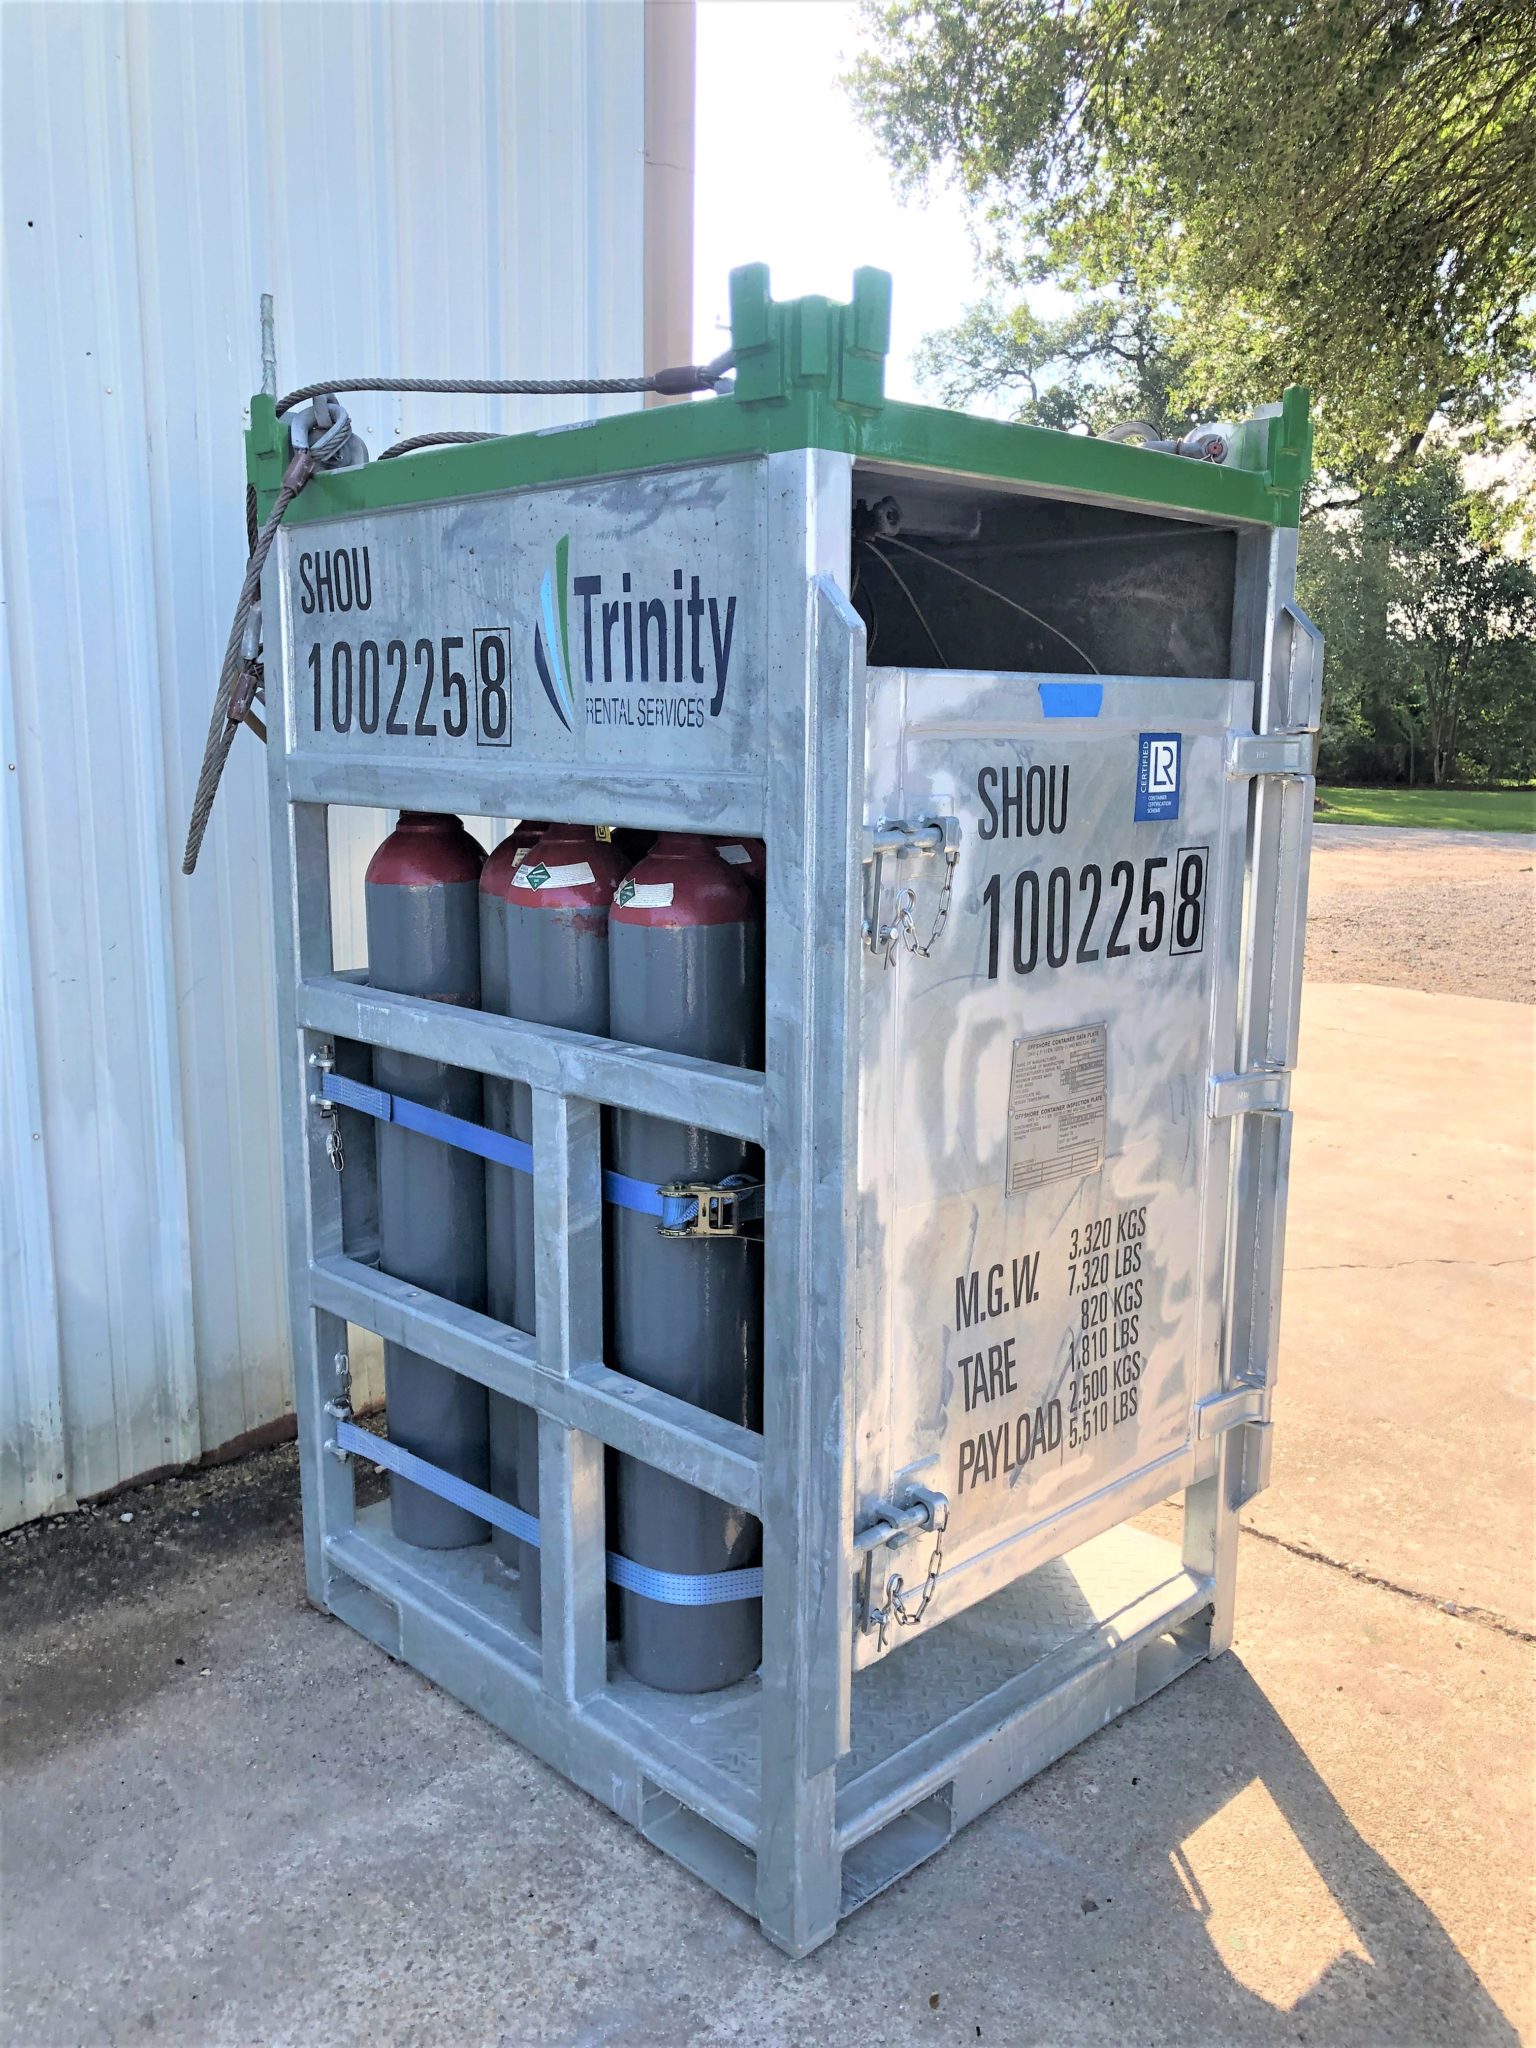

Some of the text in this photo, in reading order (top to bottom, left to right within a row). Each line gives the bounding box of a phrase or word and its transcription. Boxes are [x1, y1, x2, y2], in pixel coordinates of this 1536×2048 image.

[300, 546, 372, 615] SHOU
[574, 569, 737, 717] Trinity
[308, 633, 508, 740] 1002258
[586, 697, 705, 728] RENTAL SERVICES
[1140, 741, 1149, 794] CERTIFIED
[1153, 746, 1174, 786] LR
[977, 765, 1070, 840] SHOU
[983, 853, 1204, 979] 1002258
[1052, 1035, 1076, 1046] CONTAINER
[1015, 1110, 1039, 1120] OFFSHORE
[1041, 1104, 1066, 1115] CONTAINER
[1066, 1098, 1090, 1108] INSPECTION
[1090, 1095, 1103, 1103] PLATE
[1068, 1206, 1147, 1260] 3,320 KGS
[955, 1251, 1040, 1331] M.G.W.
[1068, 1242, 1142, 1297] 7,320 LBS
[1081, 1279, 1143, 1331] 820 KGS
[958, 1338, 1018, 1412] TARE
[1069, 1314, 1139, 1373] 1,810 LBS
[1069, 1350, 1142, 1414] 2,500 KGS
[958, 1398, 1062, 1495] PAYLOAD
[1069, 1387, 1138, 1450] 5,510 LBS
